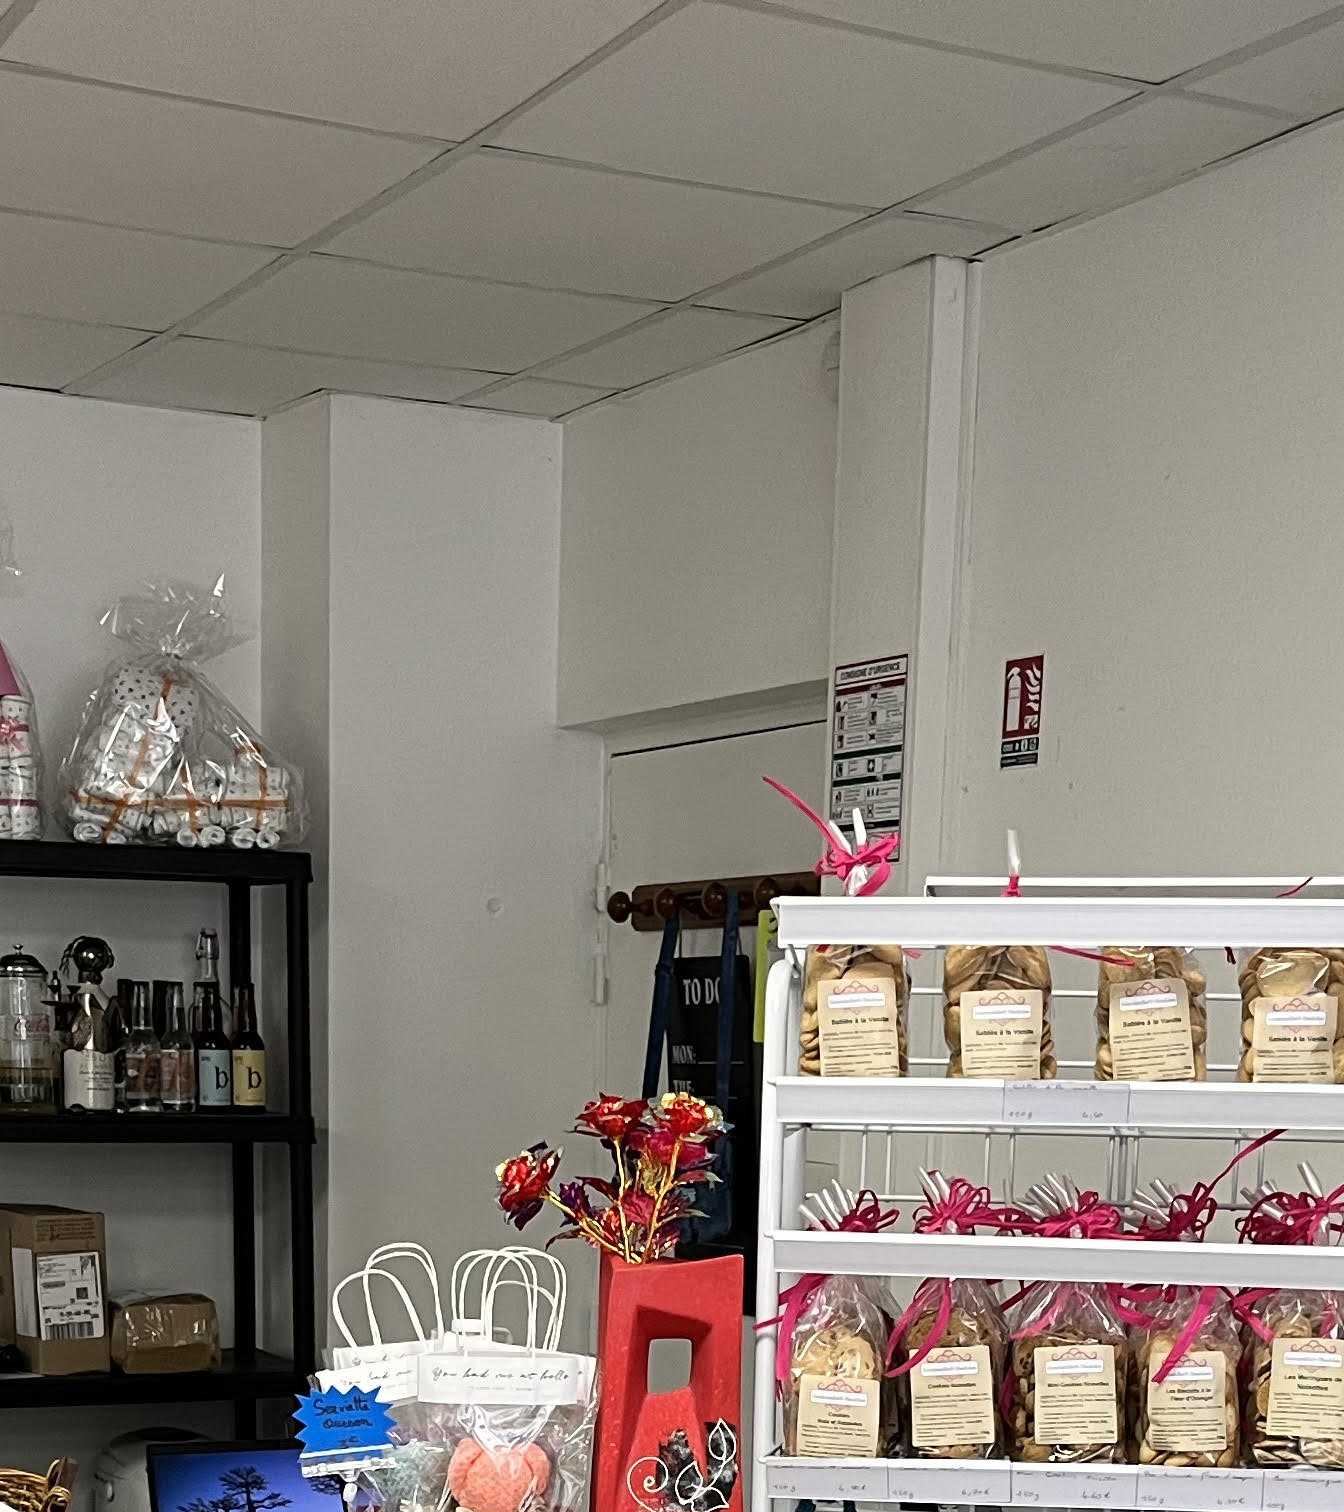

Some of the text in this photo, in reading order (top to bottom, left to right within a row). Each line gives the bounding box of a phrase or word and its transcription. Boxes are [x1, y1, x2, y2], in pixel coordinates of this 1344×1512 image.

[683, 978, 701, 1005] TO
[214, 1066, 229, 1090] b
[246, 1066, 262, 1090] b
